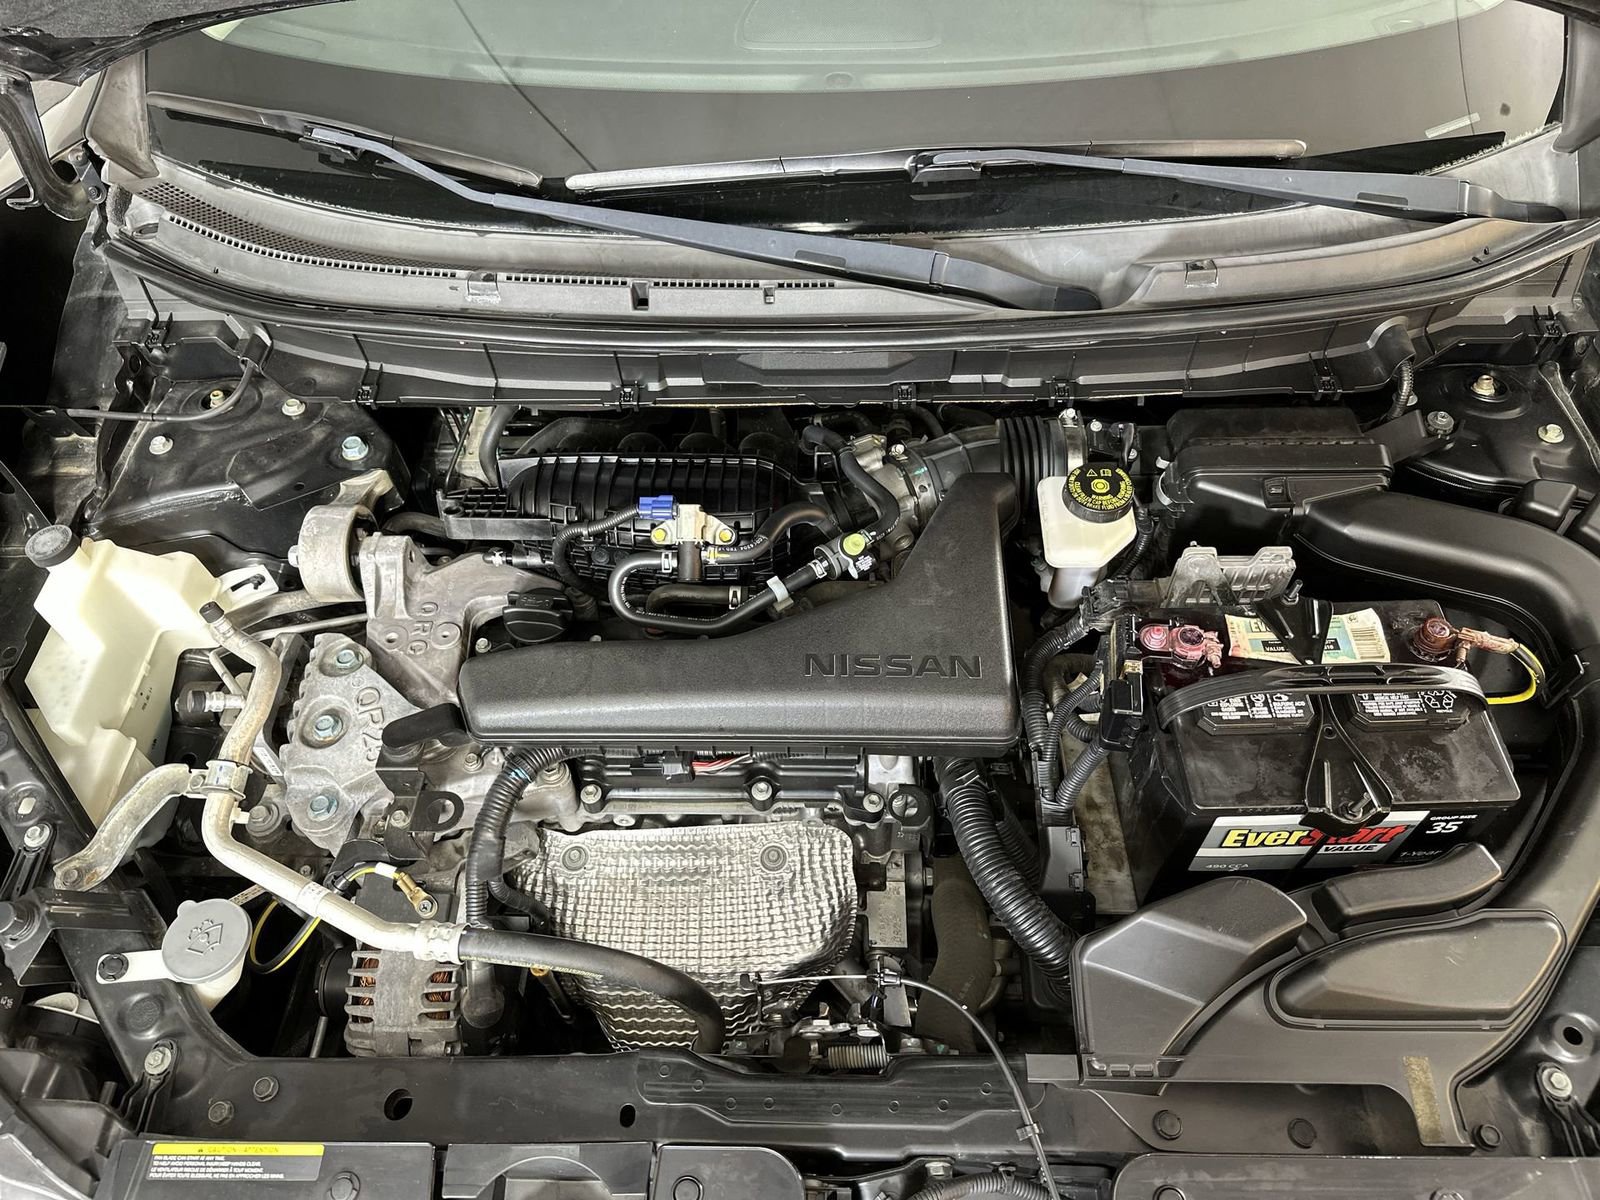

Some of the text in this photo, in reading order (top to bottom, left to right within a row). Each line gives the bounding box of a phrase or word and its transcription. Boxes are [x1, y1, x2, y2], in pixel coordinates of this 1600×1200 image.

[804, 653, 984, 680] NISSAN
[1425, 821, 1463, 833] 35
[1323, 844, 1378, 852] VALUE
